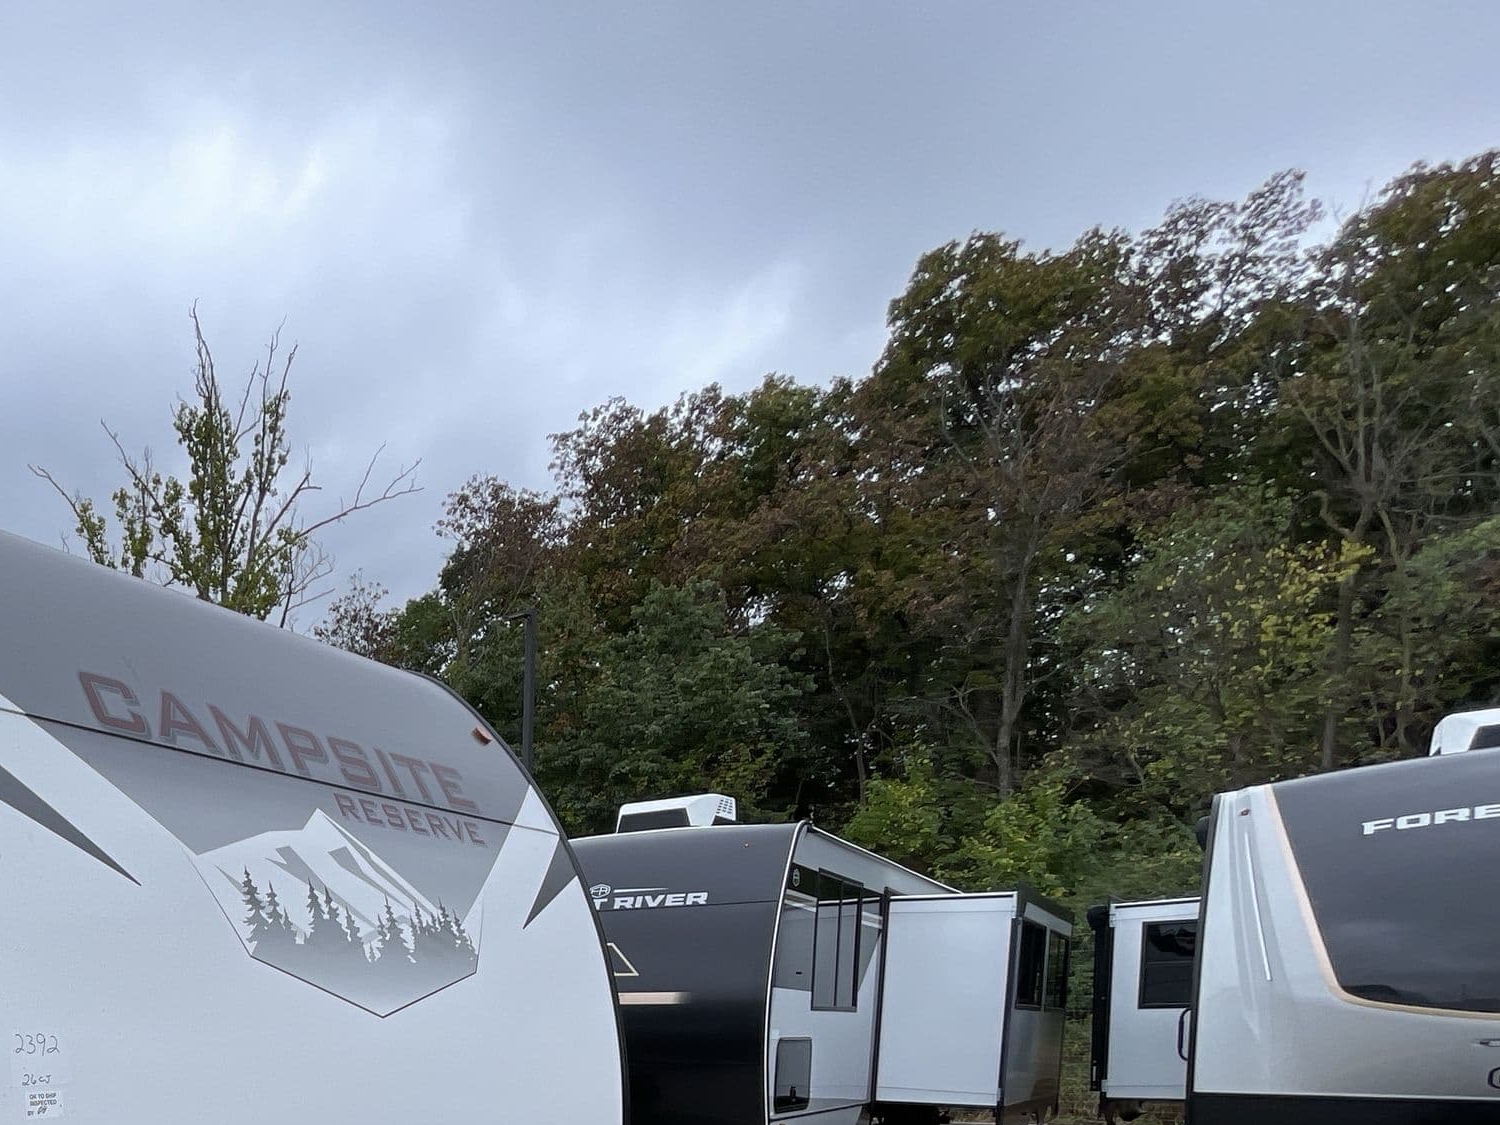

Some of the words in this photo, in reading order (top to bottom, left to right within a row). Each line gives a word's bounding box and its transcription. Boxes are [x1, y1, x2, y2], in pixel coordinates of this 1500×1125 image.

[77, 671, 480, 813] CAMPSITE
[333, 793, 488, 848] RESERVE
[613, 891, 709, 910] RIVER
[14, 1032, 60, 1057] 2392
